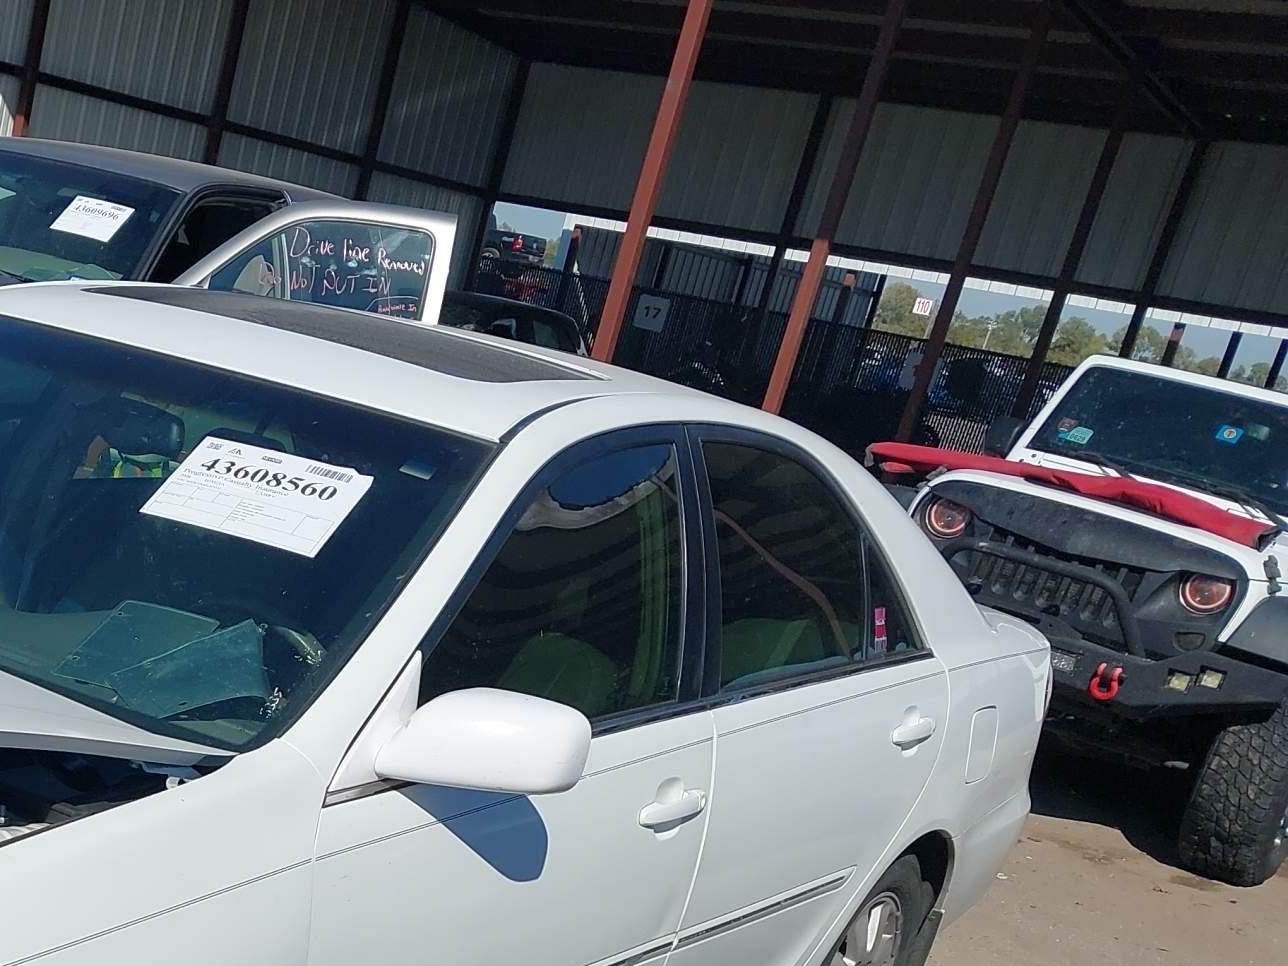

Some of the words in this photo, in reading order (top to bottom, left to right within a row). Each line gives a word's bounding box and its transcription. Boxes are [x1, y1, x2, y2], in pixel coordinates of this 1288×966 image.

[290, 226, 335, 258] Drive
[644, 305, 662, 319] 17
[916, 300, 931, 314] 110
[200, 458, 339, 501] 43608560
